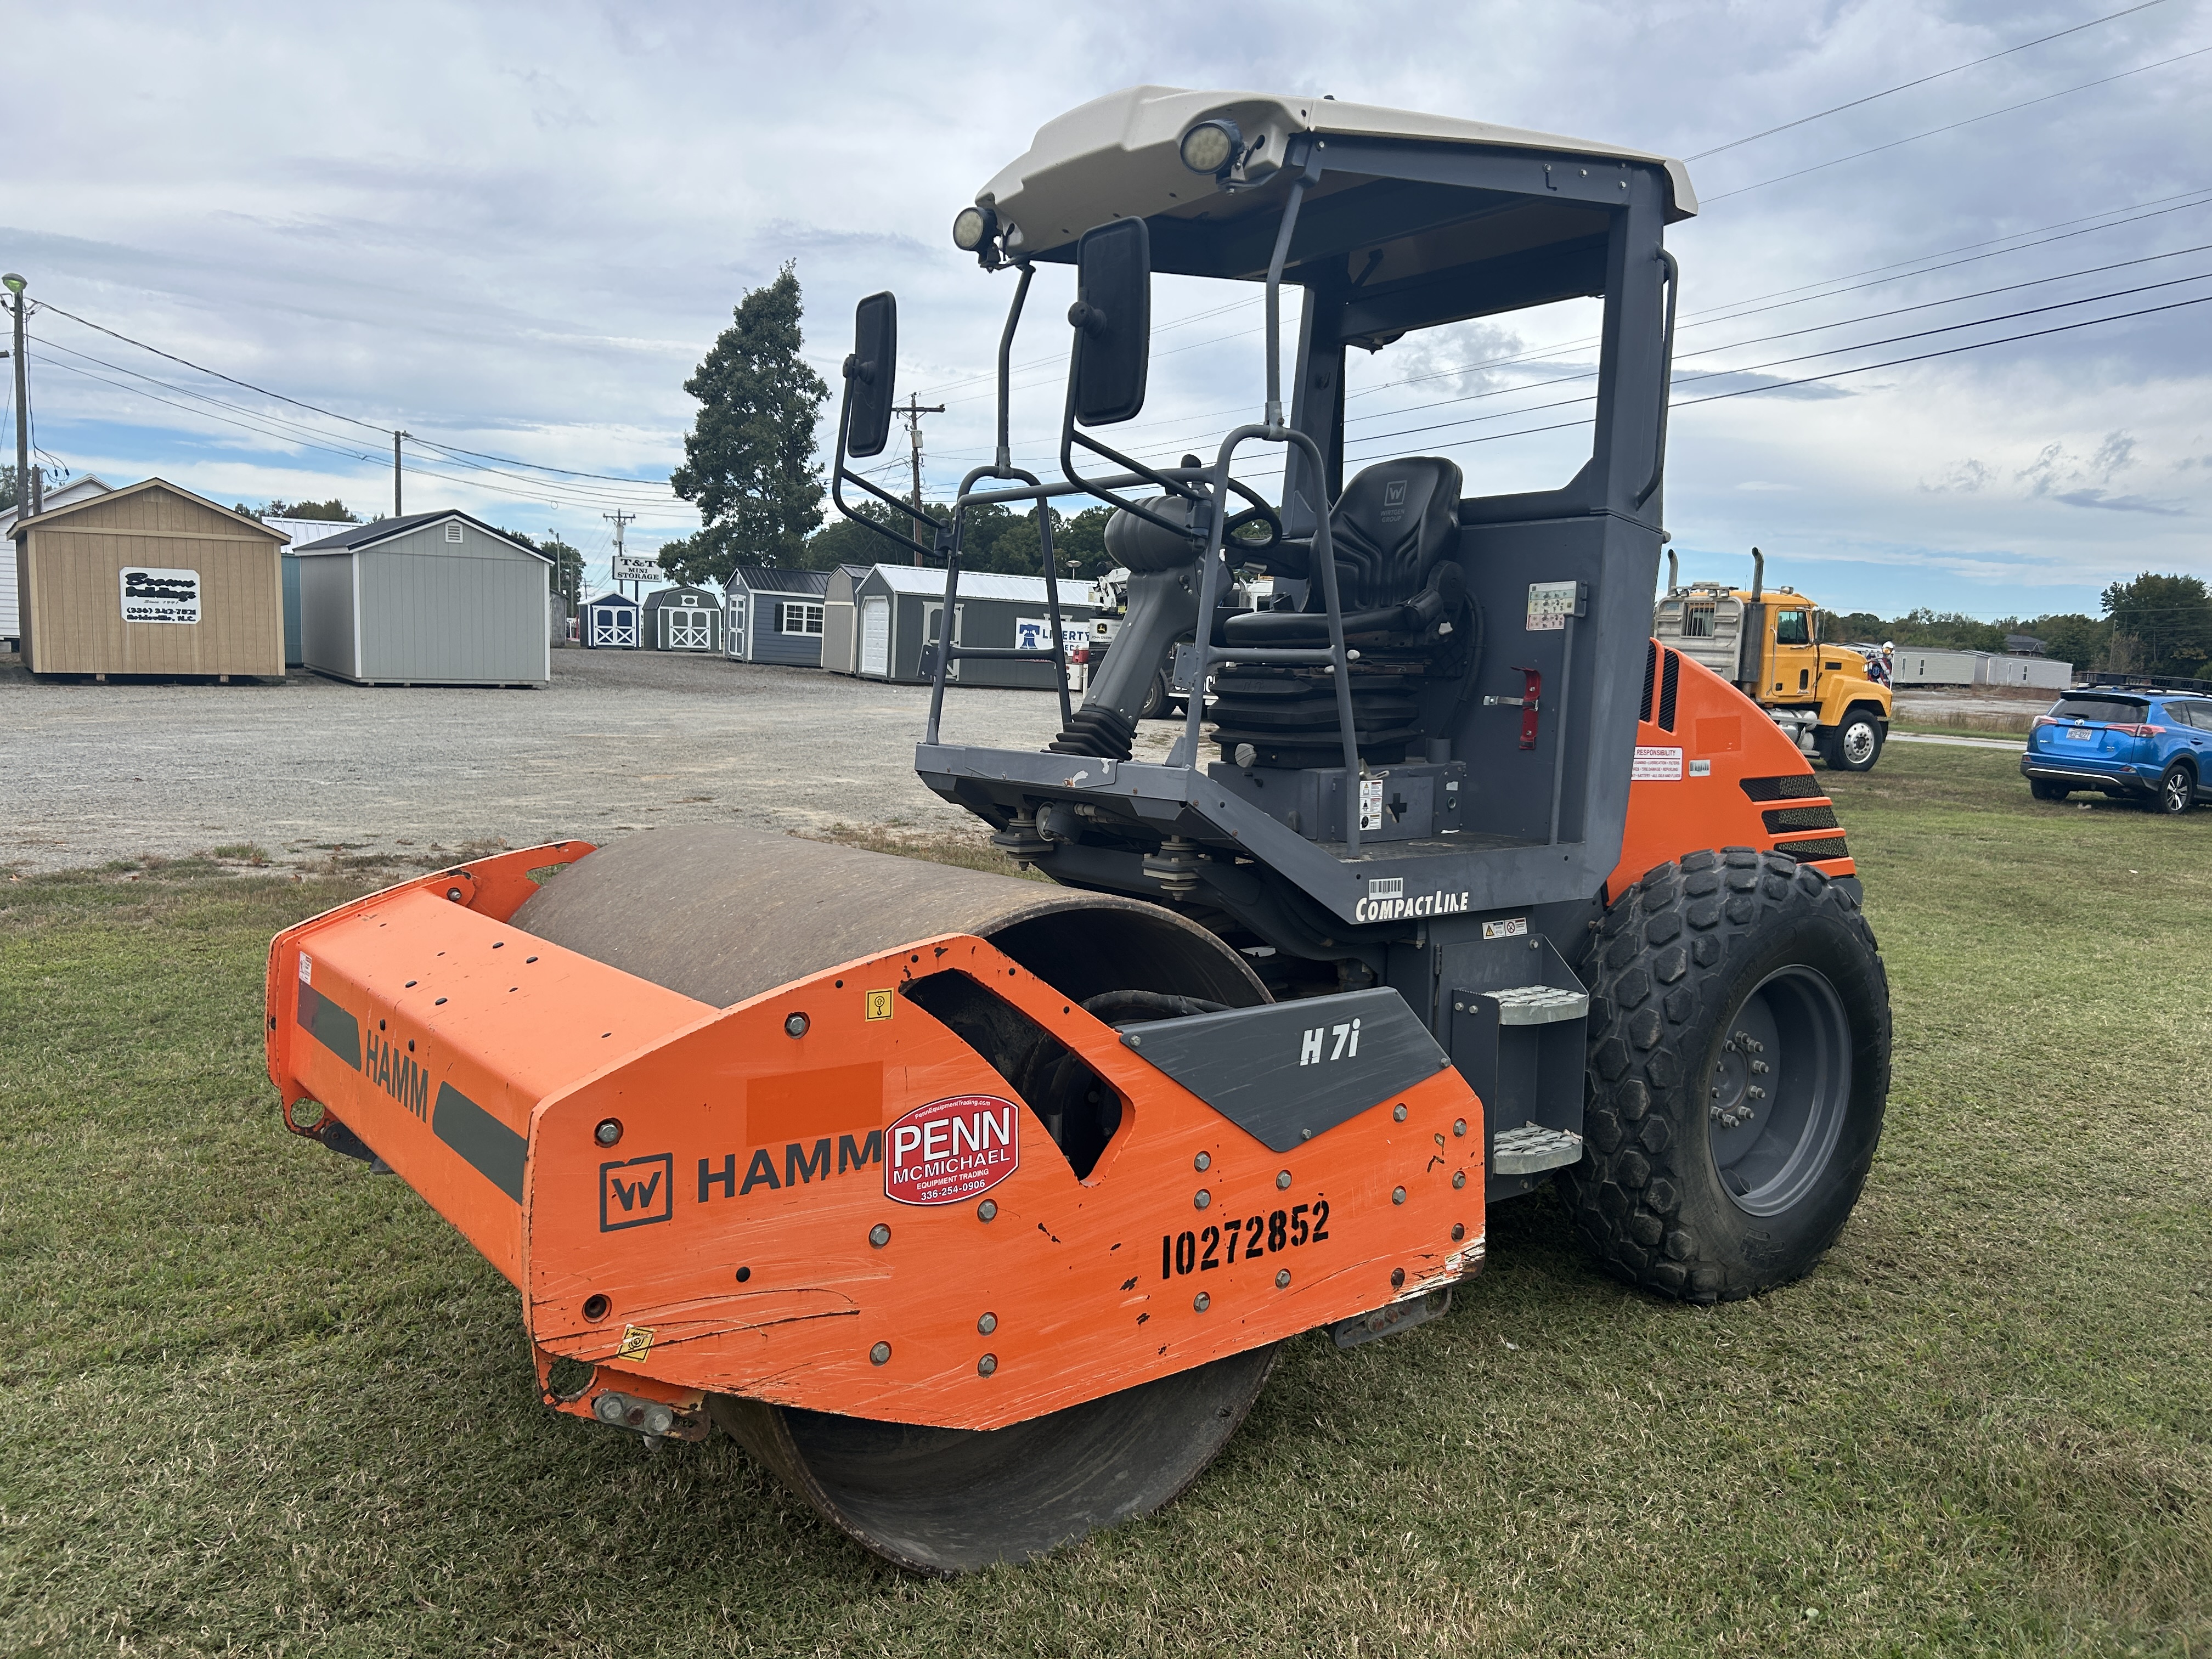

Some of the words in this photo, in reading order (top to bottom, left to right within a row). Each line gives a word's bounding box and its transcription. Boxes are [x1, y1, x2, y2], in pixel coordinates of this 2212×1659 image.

[620, 558, 657, 567] T&T
[126, 586, 196, 602] Buildings
[1042, 629, 1090, 641] LIERTY
[366, 1029, 428, 1124] HAMM
[915, 1099, 991, 1119] PennEquipmentTrading.com
[894, 1107, 1010, 1168] PENN
[698, 1130, 882, 1203] HAMM
[894, 1148, 1011, 1184] MCMICHAEL
[917, 1176, 957, 1190] EQUIPMENT
[959, 1168, 989, 1181] TRADING
[921, 1180, 985, 1200] 336-254-0906
[1162, 1200, 1329, 1280] 10272852
